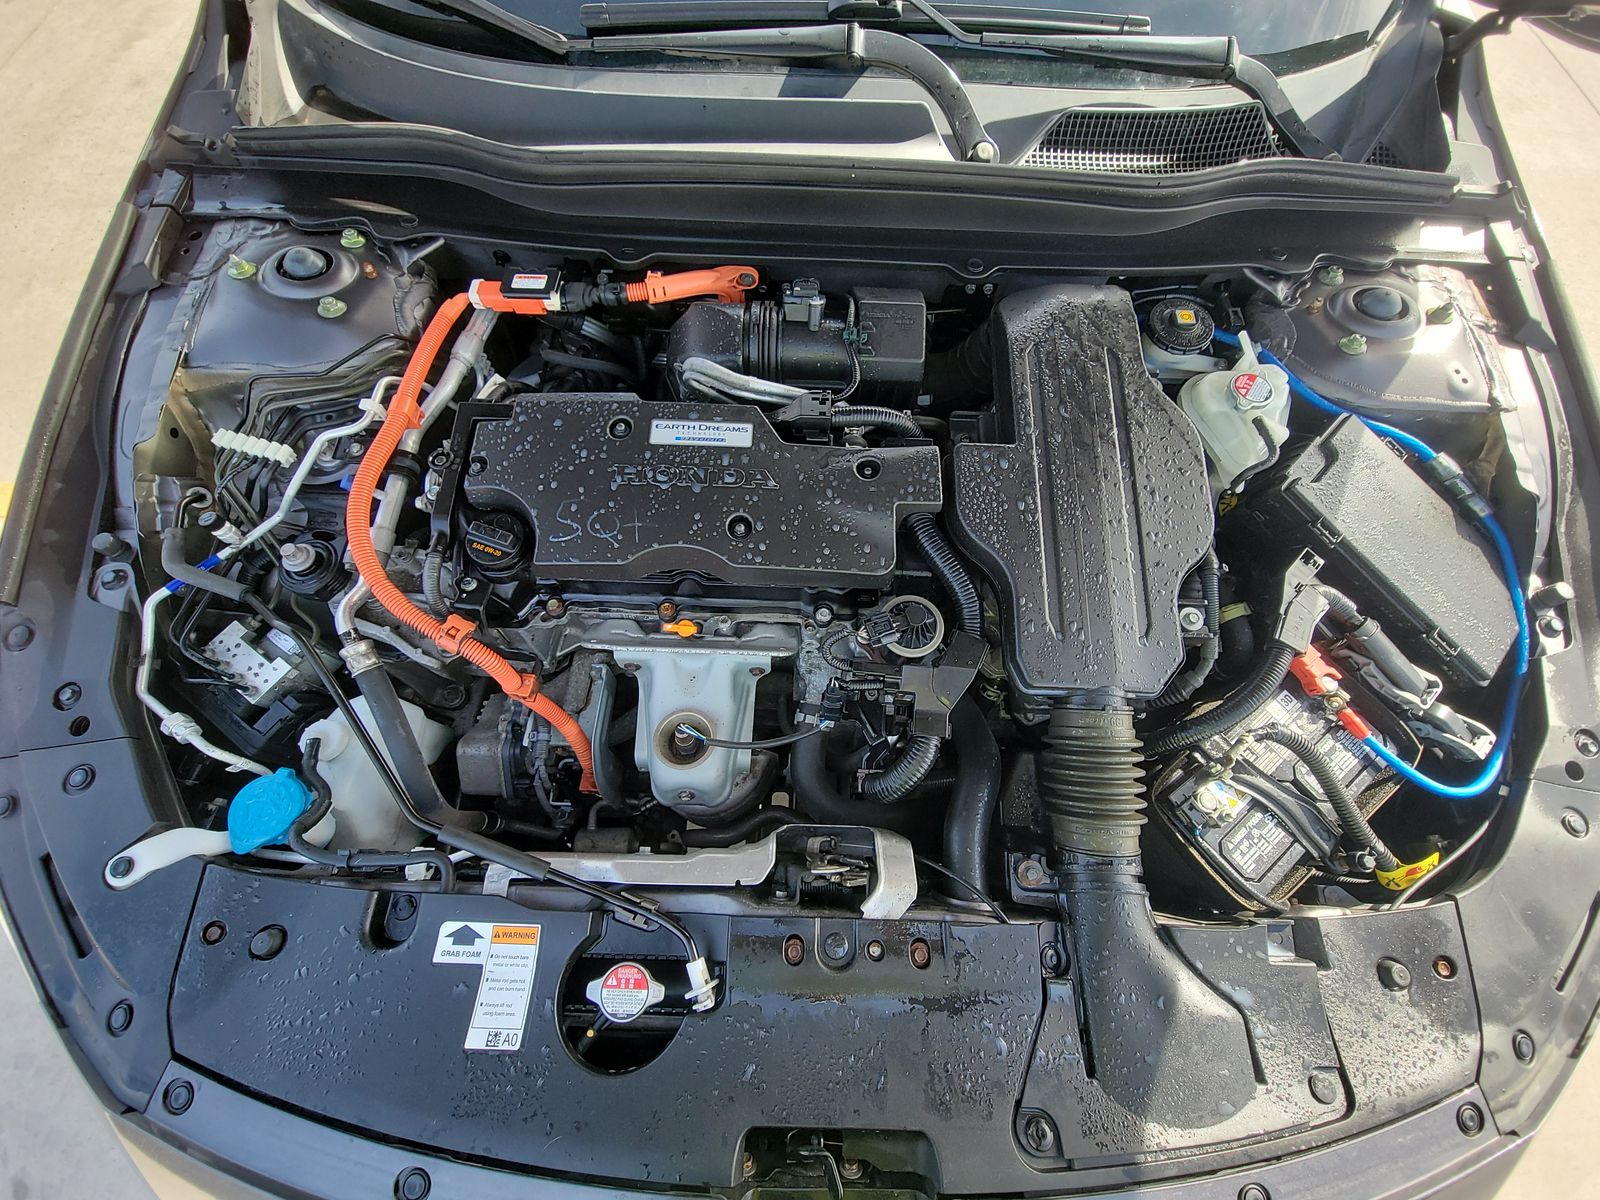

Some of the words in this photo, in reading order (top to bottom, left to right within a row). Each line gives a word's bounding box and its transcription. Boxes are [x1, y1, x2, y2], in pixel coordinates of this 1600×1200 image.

[698, 424, 748, 433] DREAMS
[608, 464, 780, 489] HONDA
[472, 542, 485, 550] SAE
[484, 546, 502, 557] 0W-20
[1280, 693, 1294, 707] 3D
[502, 932, 536, 940] WARNING
[501, 1033, 518, 1047] A0
